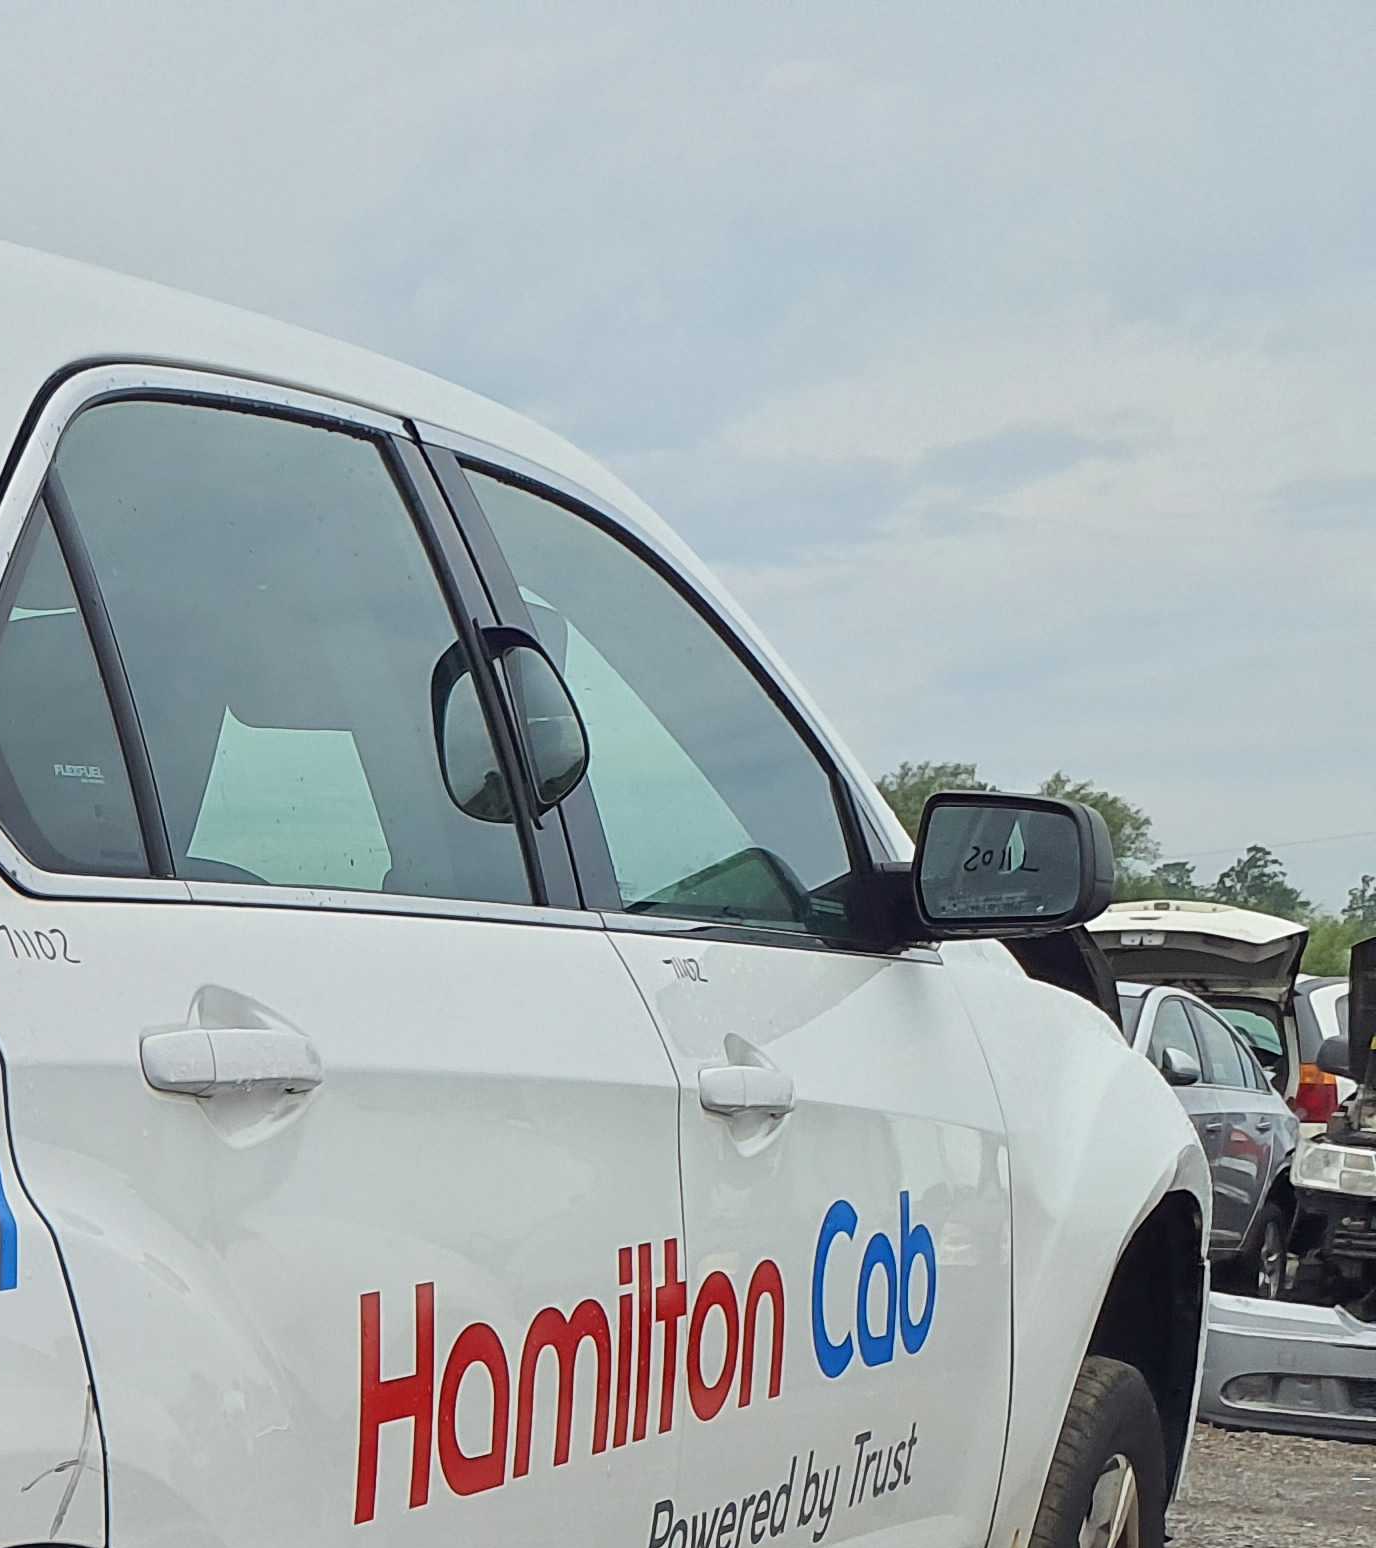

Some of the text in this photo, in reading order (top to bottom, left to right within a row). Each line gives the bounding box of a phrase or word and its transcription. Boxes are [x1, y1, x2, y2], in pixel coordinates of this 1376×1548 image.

[353, 1189, 937, 1526] Hamilton Cab
[797, 1450, 841, 1543] by
[848, 1422, 918, 1508] Trust
